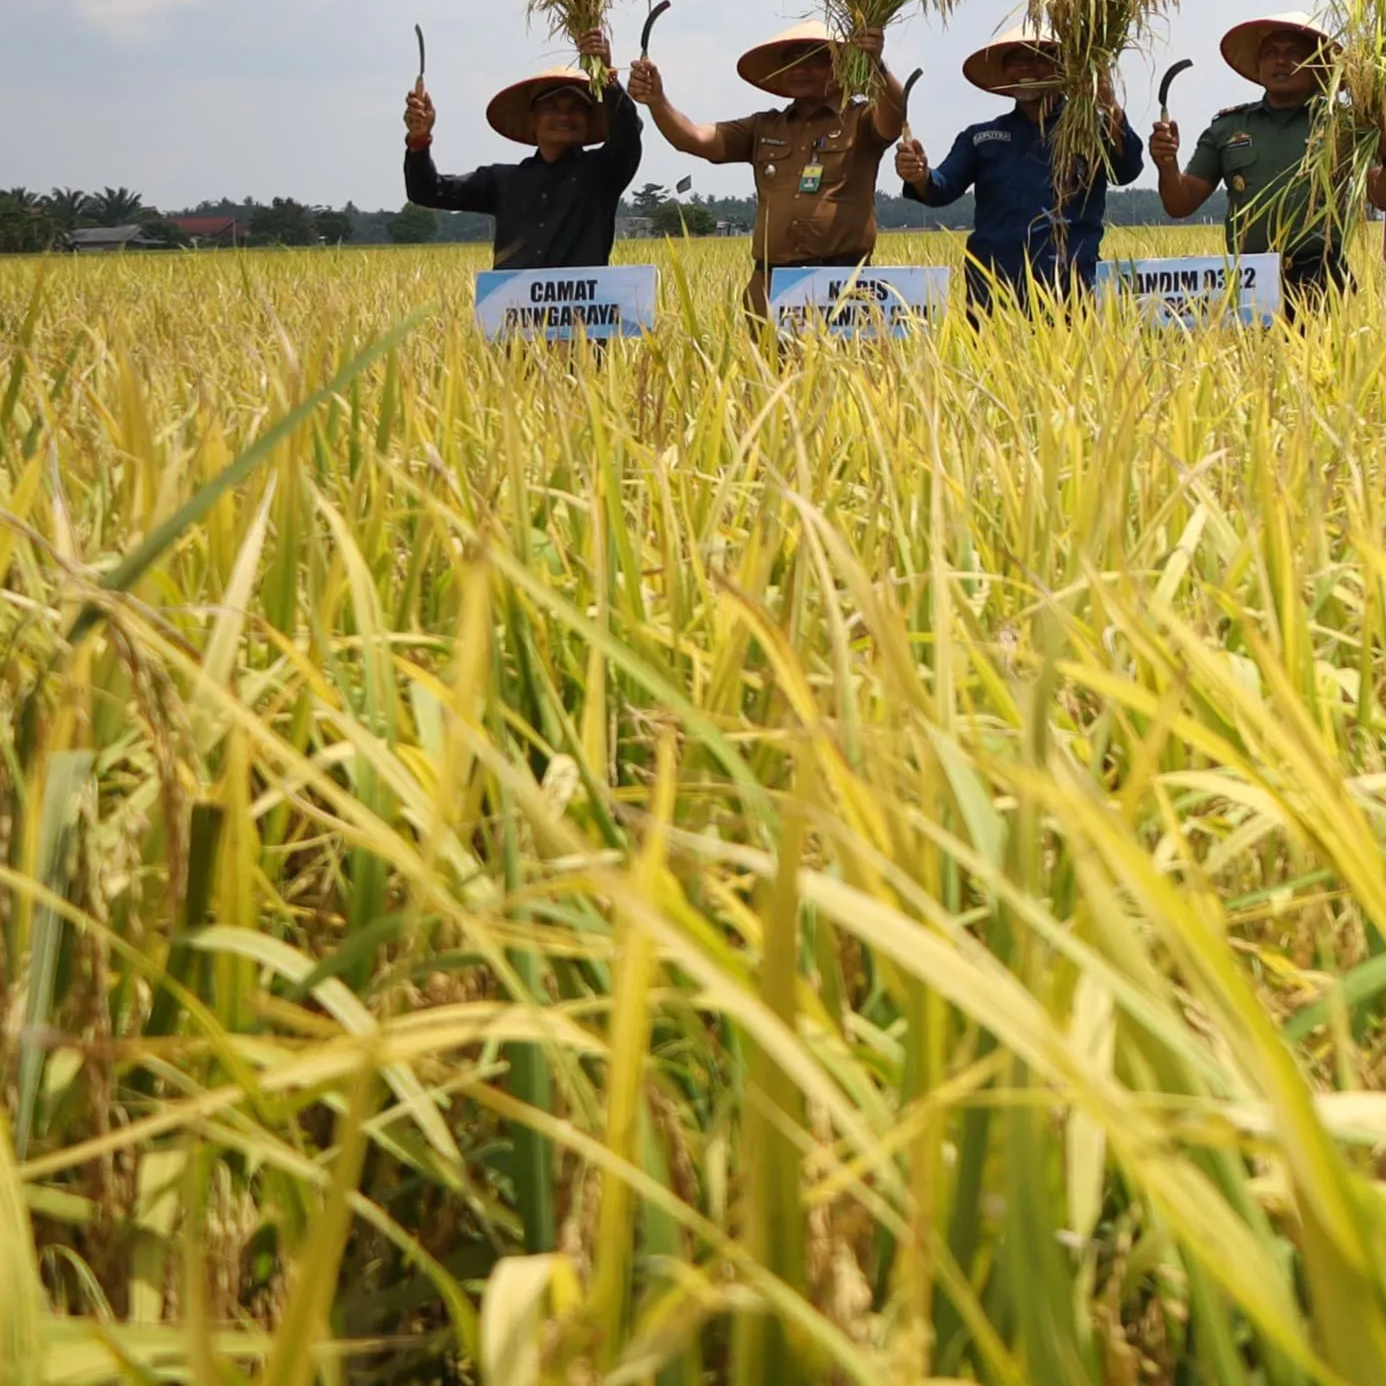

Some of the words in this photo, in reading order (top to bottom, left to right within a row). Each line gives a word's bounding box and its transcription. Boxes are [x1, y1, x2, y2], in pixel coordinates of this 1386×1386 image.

[530, 279, 598, 303] CAMAT
[1203, 267, 1256, 291] 032
[505, 304, 620, 328] BUNGARAYA
